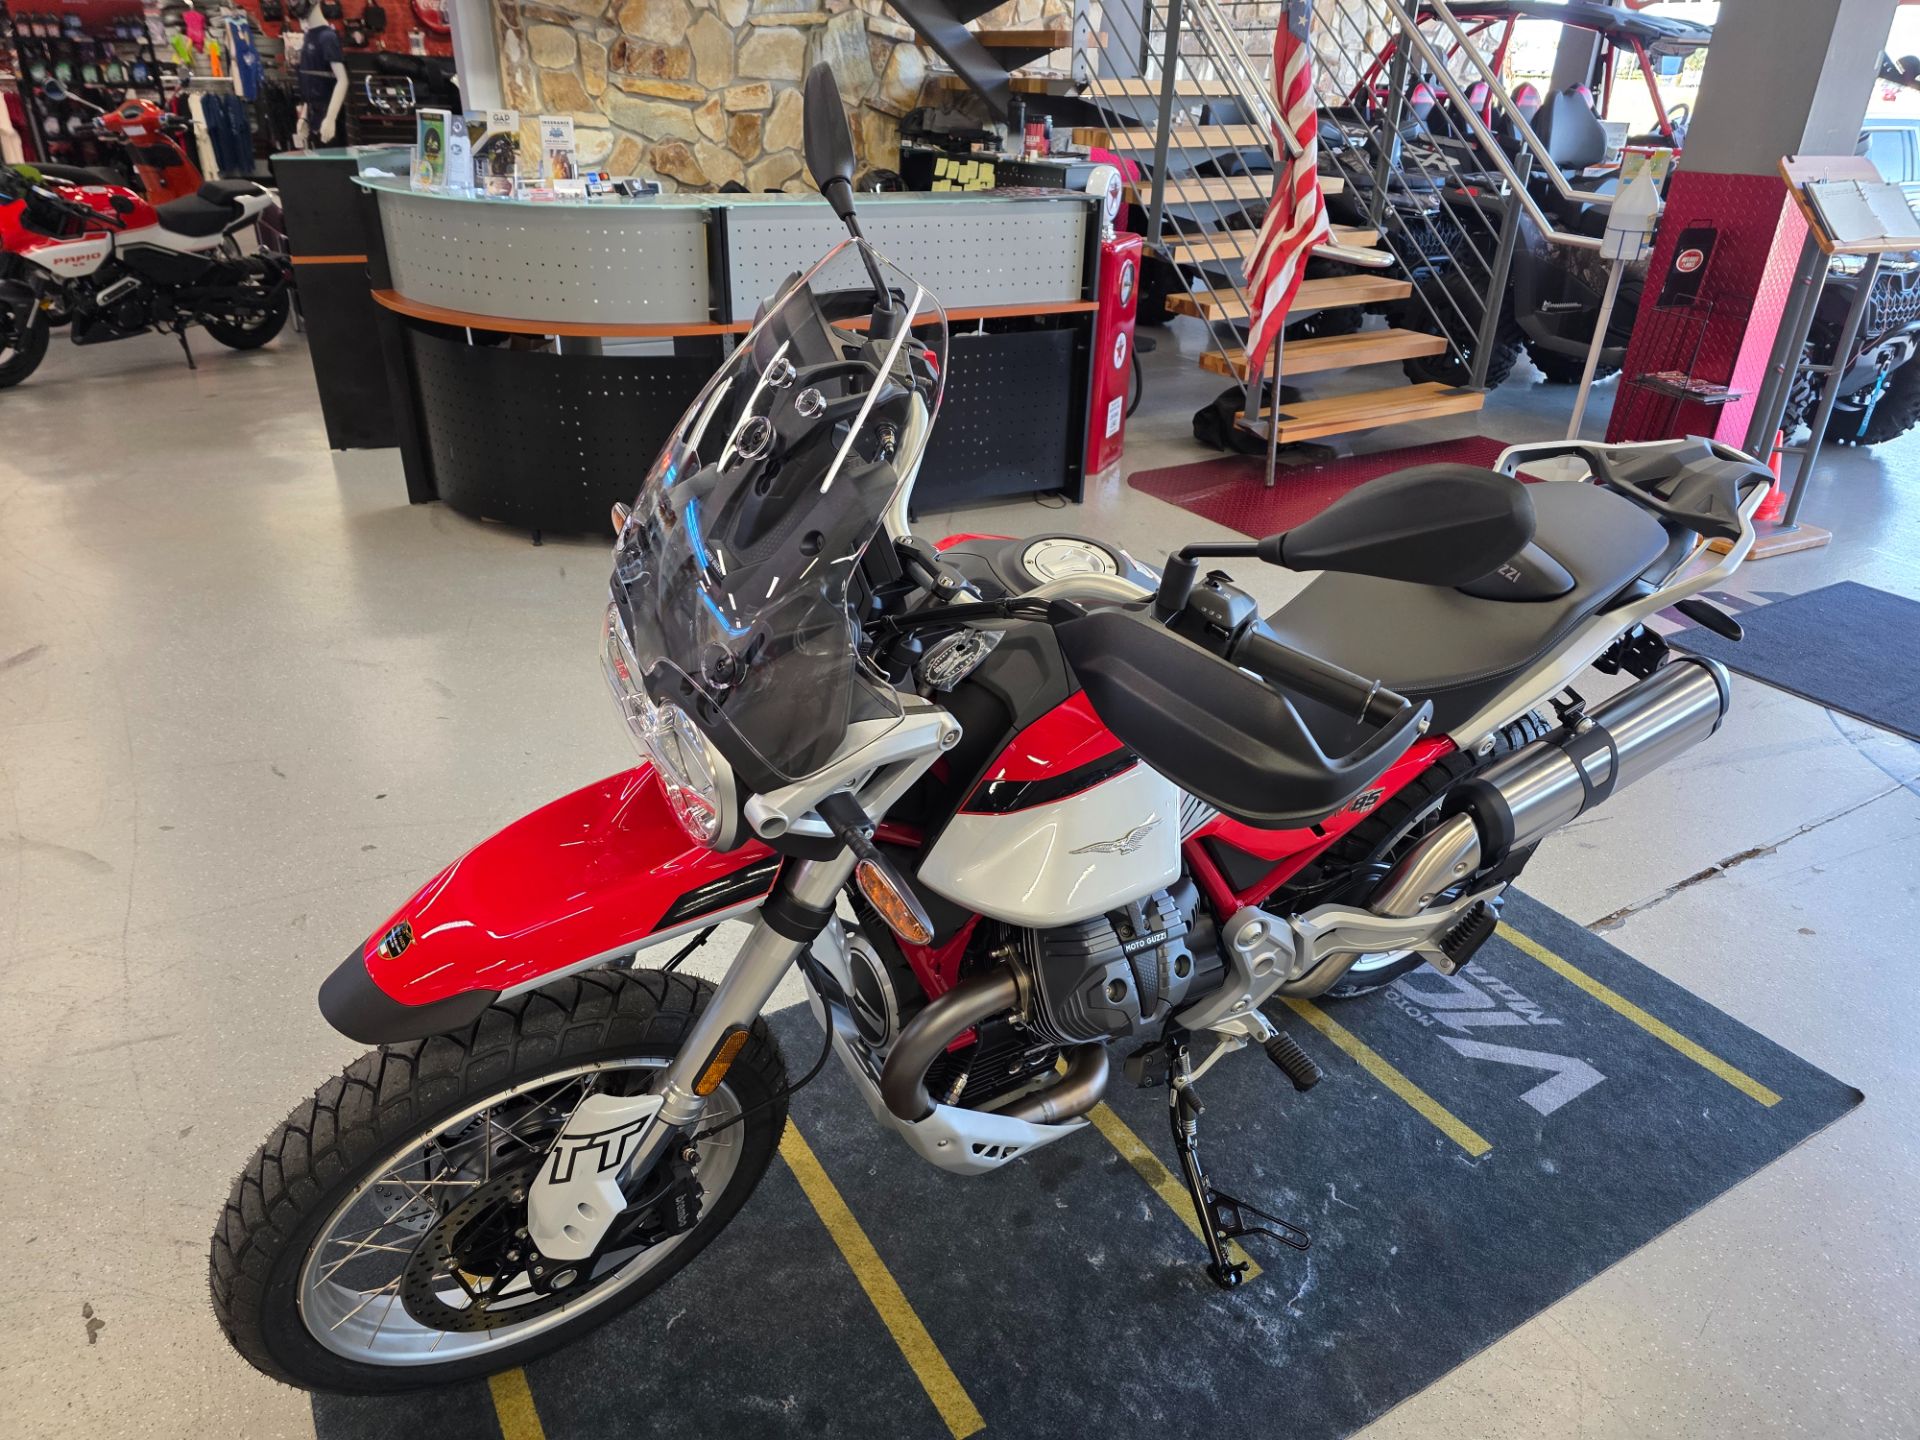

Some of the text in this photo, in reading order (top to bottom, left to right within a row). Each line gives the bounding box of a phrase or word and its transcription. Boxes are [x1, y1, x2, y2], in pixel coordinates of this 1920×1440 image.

[53, 252, 101, 265] PAPIO
[1125, 931, 1167, 952] MOTO GUZZI
[1384, 989, 1437, 1027] MOTO
[548, 1113, 653, 1185] TT
